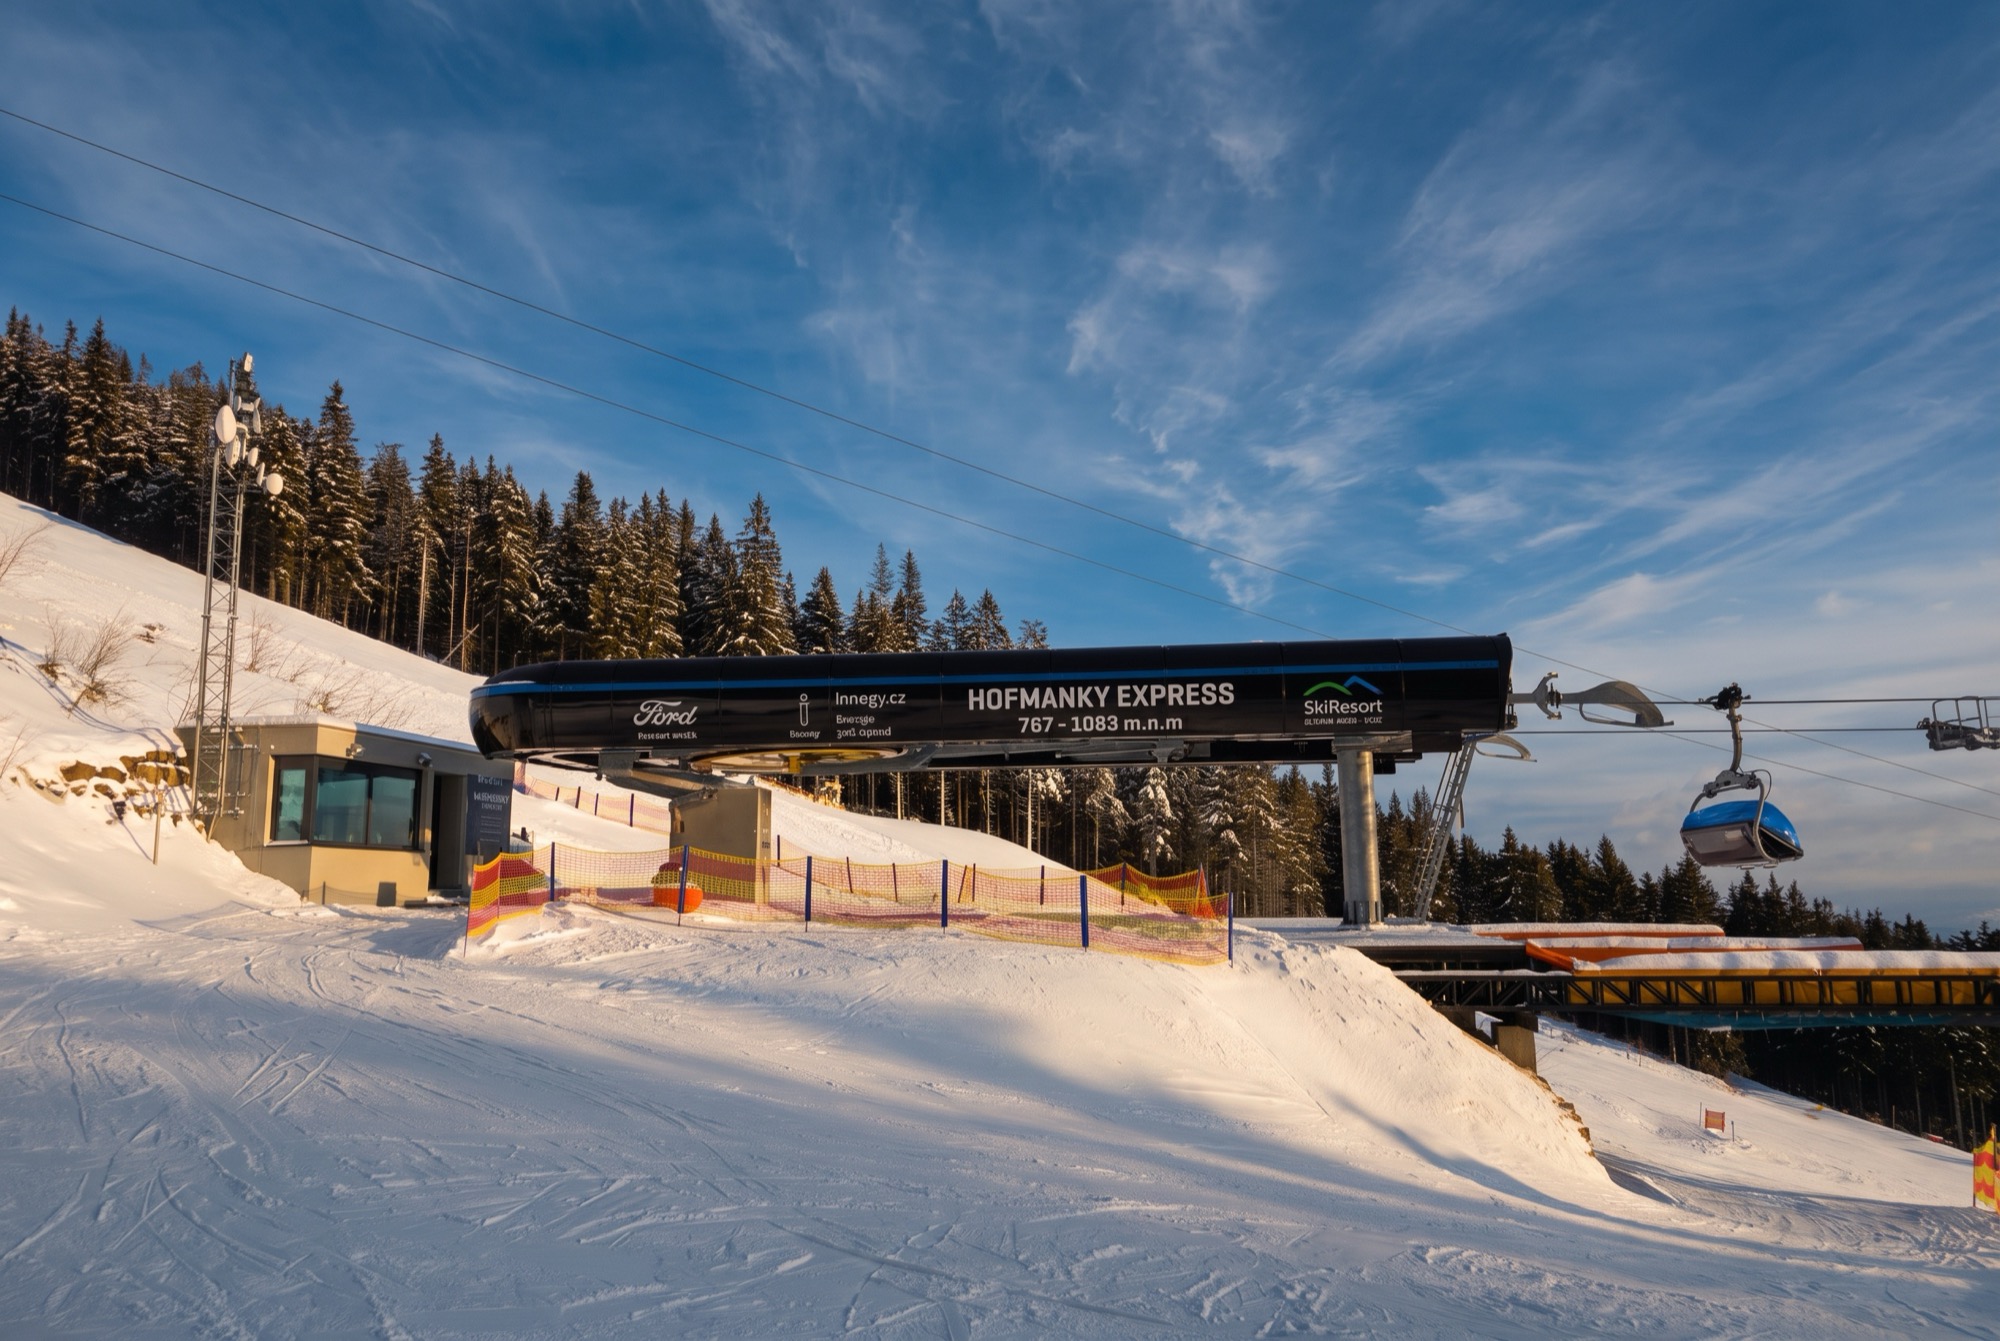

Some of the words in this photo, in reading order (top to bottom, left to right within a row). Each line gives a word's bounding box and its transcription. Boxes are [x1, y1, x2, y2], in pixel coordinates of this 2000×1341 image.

[835, 691, 906, 709] Innegy.cz
[968, 686, 1110, 711] HOFMANKY
[1117, 682, 1235, 707] EXPRESS
[633, 699, 698, 726] Ford
[1304, 699, 1383, 715] SkiResort
[1018, 716, 1054, 733] 767
[1071, 715, 1119, 732] 1083
[1124, 716, 1183, 731] m.n.m
